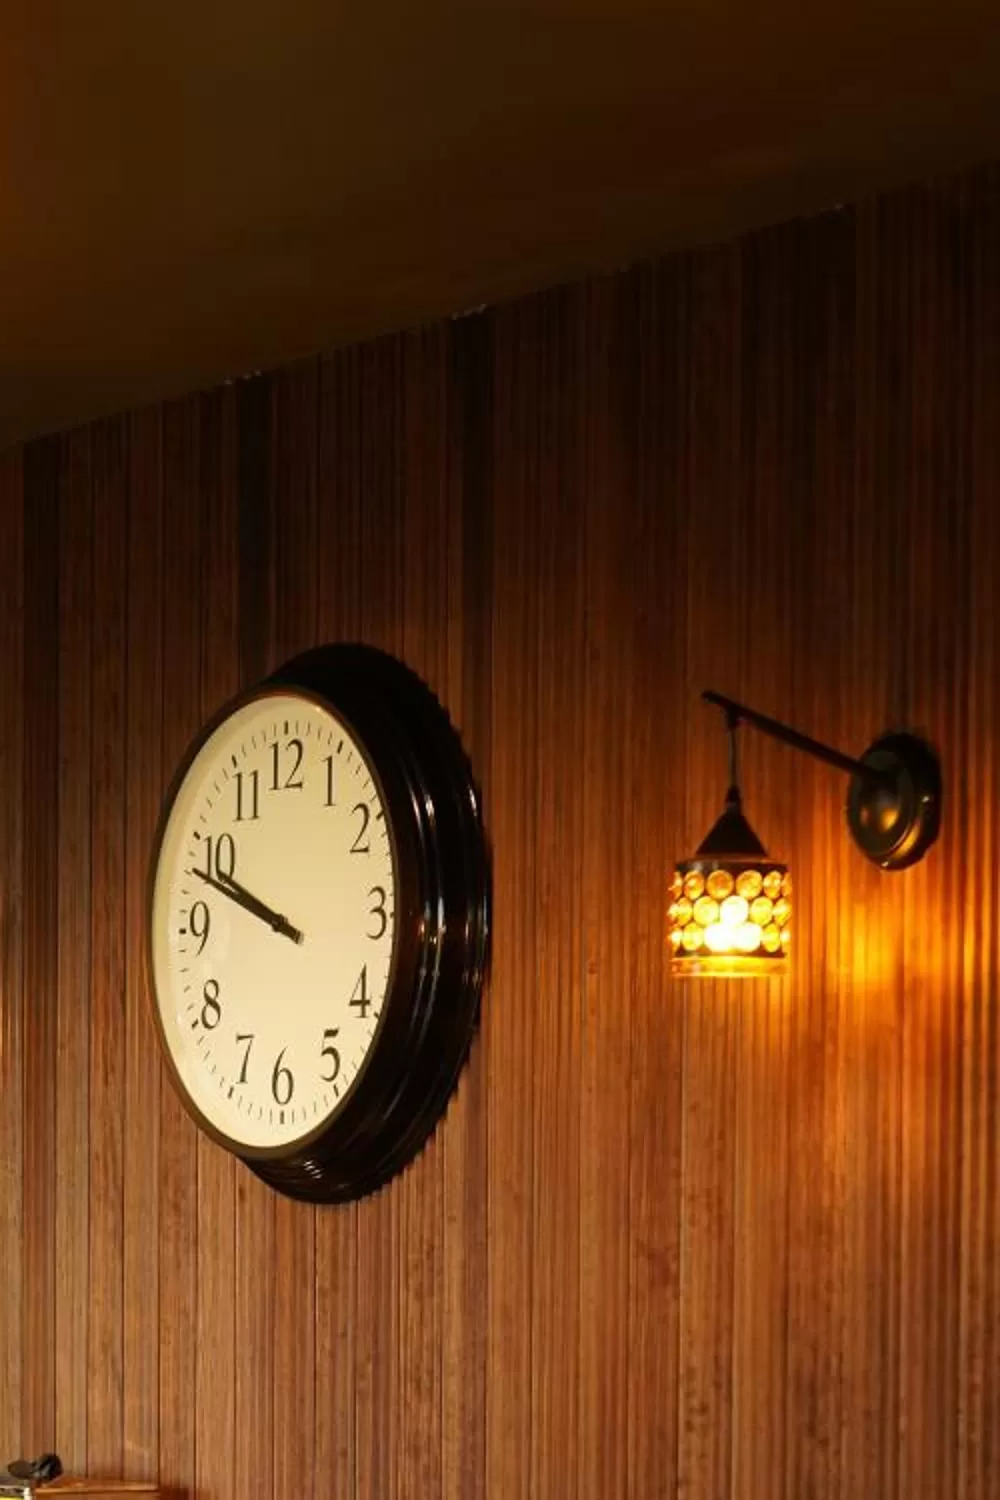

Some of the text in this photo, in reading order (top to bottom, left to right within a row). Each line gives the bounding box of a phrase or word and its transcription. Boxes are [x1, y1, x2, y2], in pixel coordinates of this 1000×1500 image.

[268, 738, 304, 791] 12
[321, 754, 337, 807] 1
[232, 768, 260, 822] 11
[349, 802, 371, 854] 2
[203, 832, 236, 885] 10
[189, 900, 211, 956] 9
[365, 885, 388, 941] 3
[201, 979, 222, 1030] 8
[348, 963, 371, 1019] 4
[236, 1034, 255, 1085] 7
[271, 1045, 294, 1106] 6
[320, 1027, 342, 1083] 5
